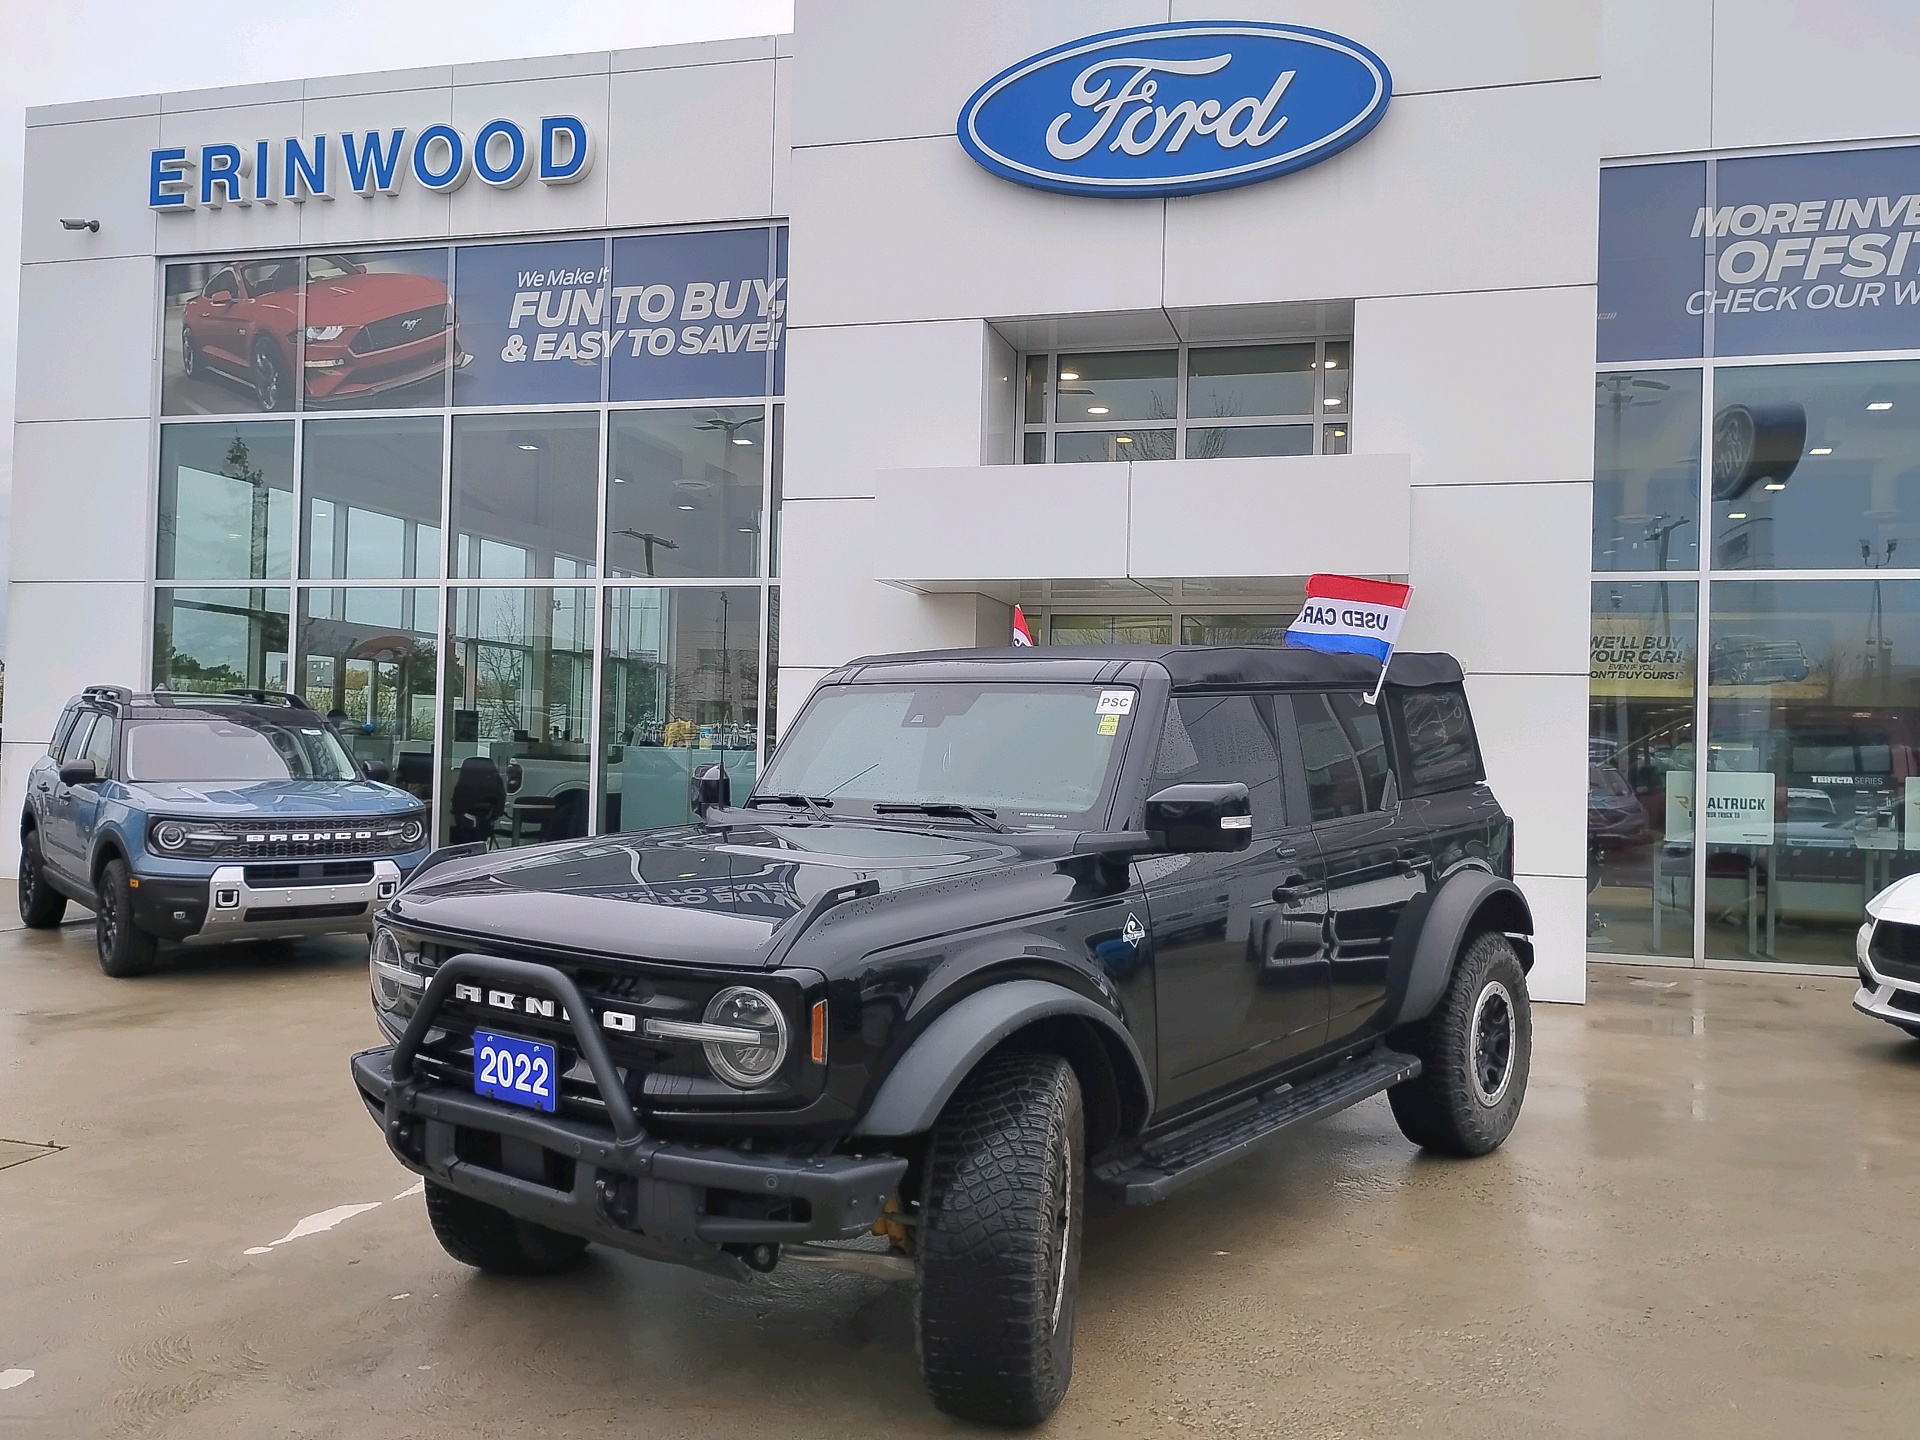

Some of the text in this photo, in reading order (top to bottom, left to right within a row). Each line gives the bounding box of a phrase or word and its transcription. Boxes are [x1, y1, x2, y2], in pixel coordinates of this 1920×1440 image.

[1046, 53, 1297, 161] Ford
[149, 115, 594, 212] ERINWOOD
[1690, 200, 1826, 238] MORE
[1717, 231, 1920, 284] OFFSI
[517, 266, 609, 288] We Make It
[508, 288, 605, 329] FUN
[611, 285, 676, 324] TO
[1685, 285, 1802, 316] CHECK
[1806, 282, 1886, 310] OUR
[501, 322, 783, 362] & EASY TO SAVE!
[1638, 650, 1682, 663] CAR!
[1643, 636, 1682, 650] BUY
[1590, 670, 1618, 679] ON'T
[1618, 671, 1643, 679] BUY
[1101, 698, 1129, 707] PSC
[1854, 777, 1883, 785] SERIES
[245, 830, 372, 843] BRONCO
[479, 1046, 550, 1098] 2022
